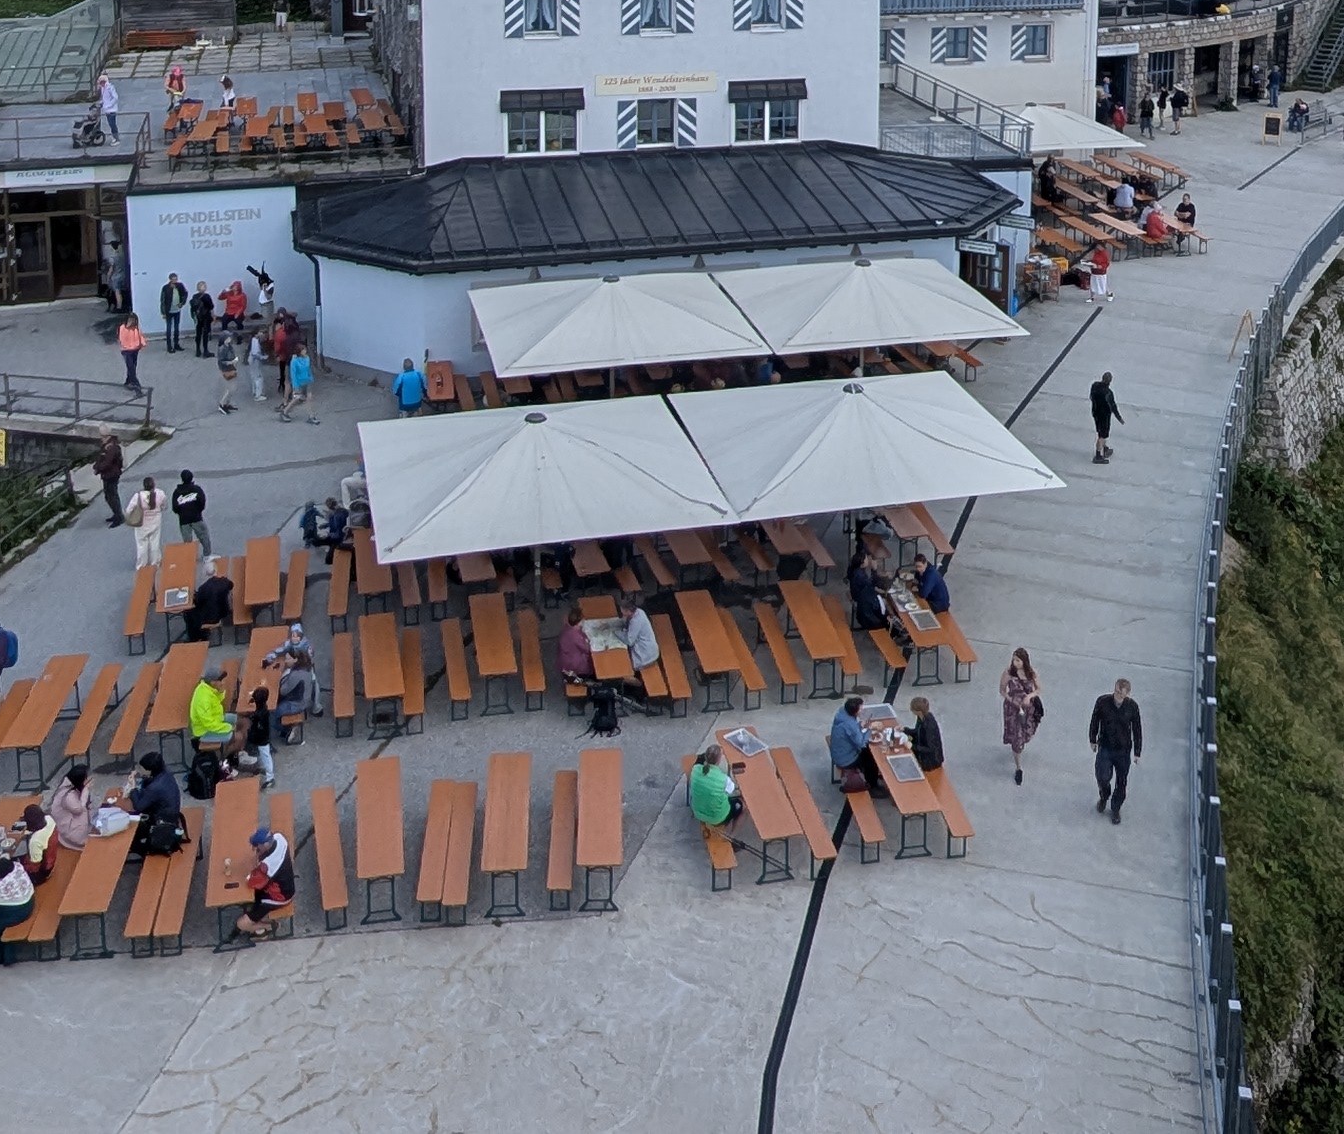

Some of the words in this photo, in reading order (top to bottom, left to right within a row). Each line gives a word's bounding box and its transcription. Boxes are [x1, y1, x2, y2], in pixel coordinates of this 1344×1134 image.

[604, 78, 618, 86] 125
[620, 76, 641, 85] Jahre
[643, 74, 709, 84] Wendelsteinhaus
[159, 208, 261, 226] WENDELSTEIN
[191, 224, 232, 238] HAUS
[191, 240, 218, 249] 1724
[221, 240, 233, 248] m
